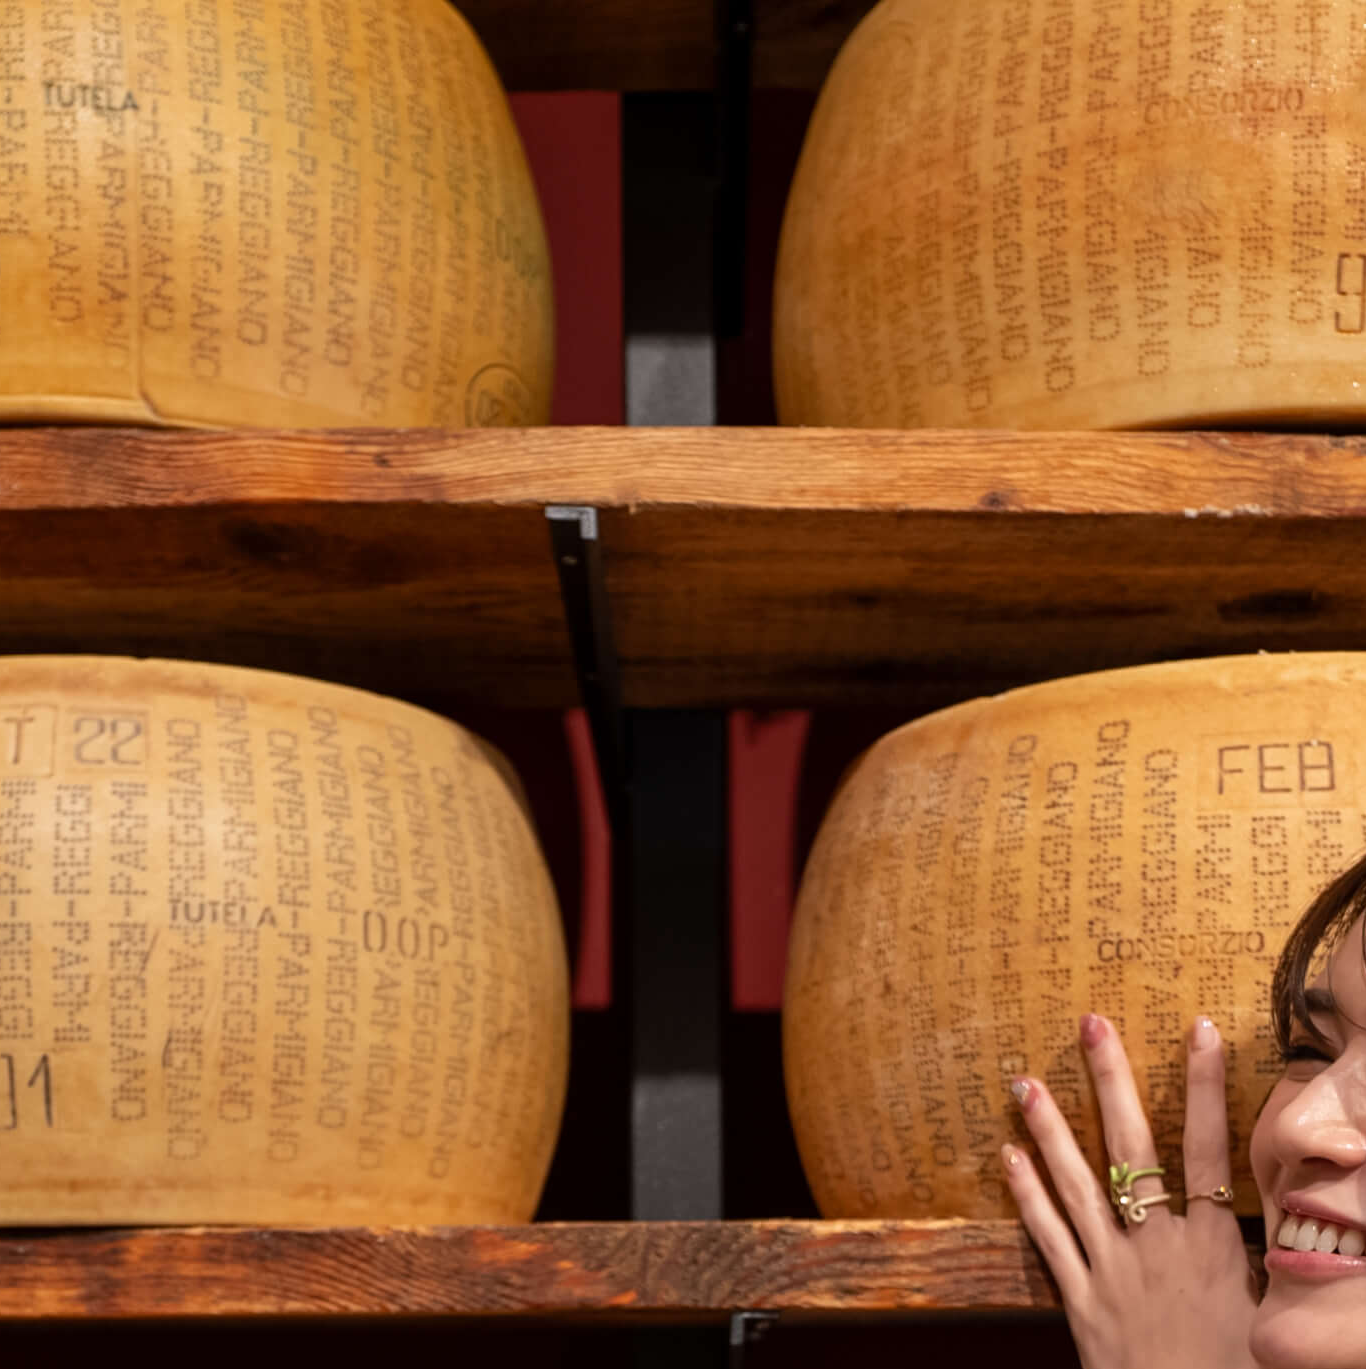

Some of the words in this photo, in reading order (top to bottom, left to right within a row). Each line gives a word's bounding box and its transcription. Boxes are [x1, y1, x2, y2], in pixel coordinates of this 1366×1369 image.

[43, 82, 140, 112] TUTELA
[1143, 86, 1305, 126] CONSORZIO
[74, 716, 143, 766] 22
[1217, 741, 1336, 794] FEB
[53, 784, 91, 896] REGGI
[168, 902, 278, 928] TUTELA
[363, 909, 449, 953] DOP
[1097, 930, 1267, 963] CONSORZIO
